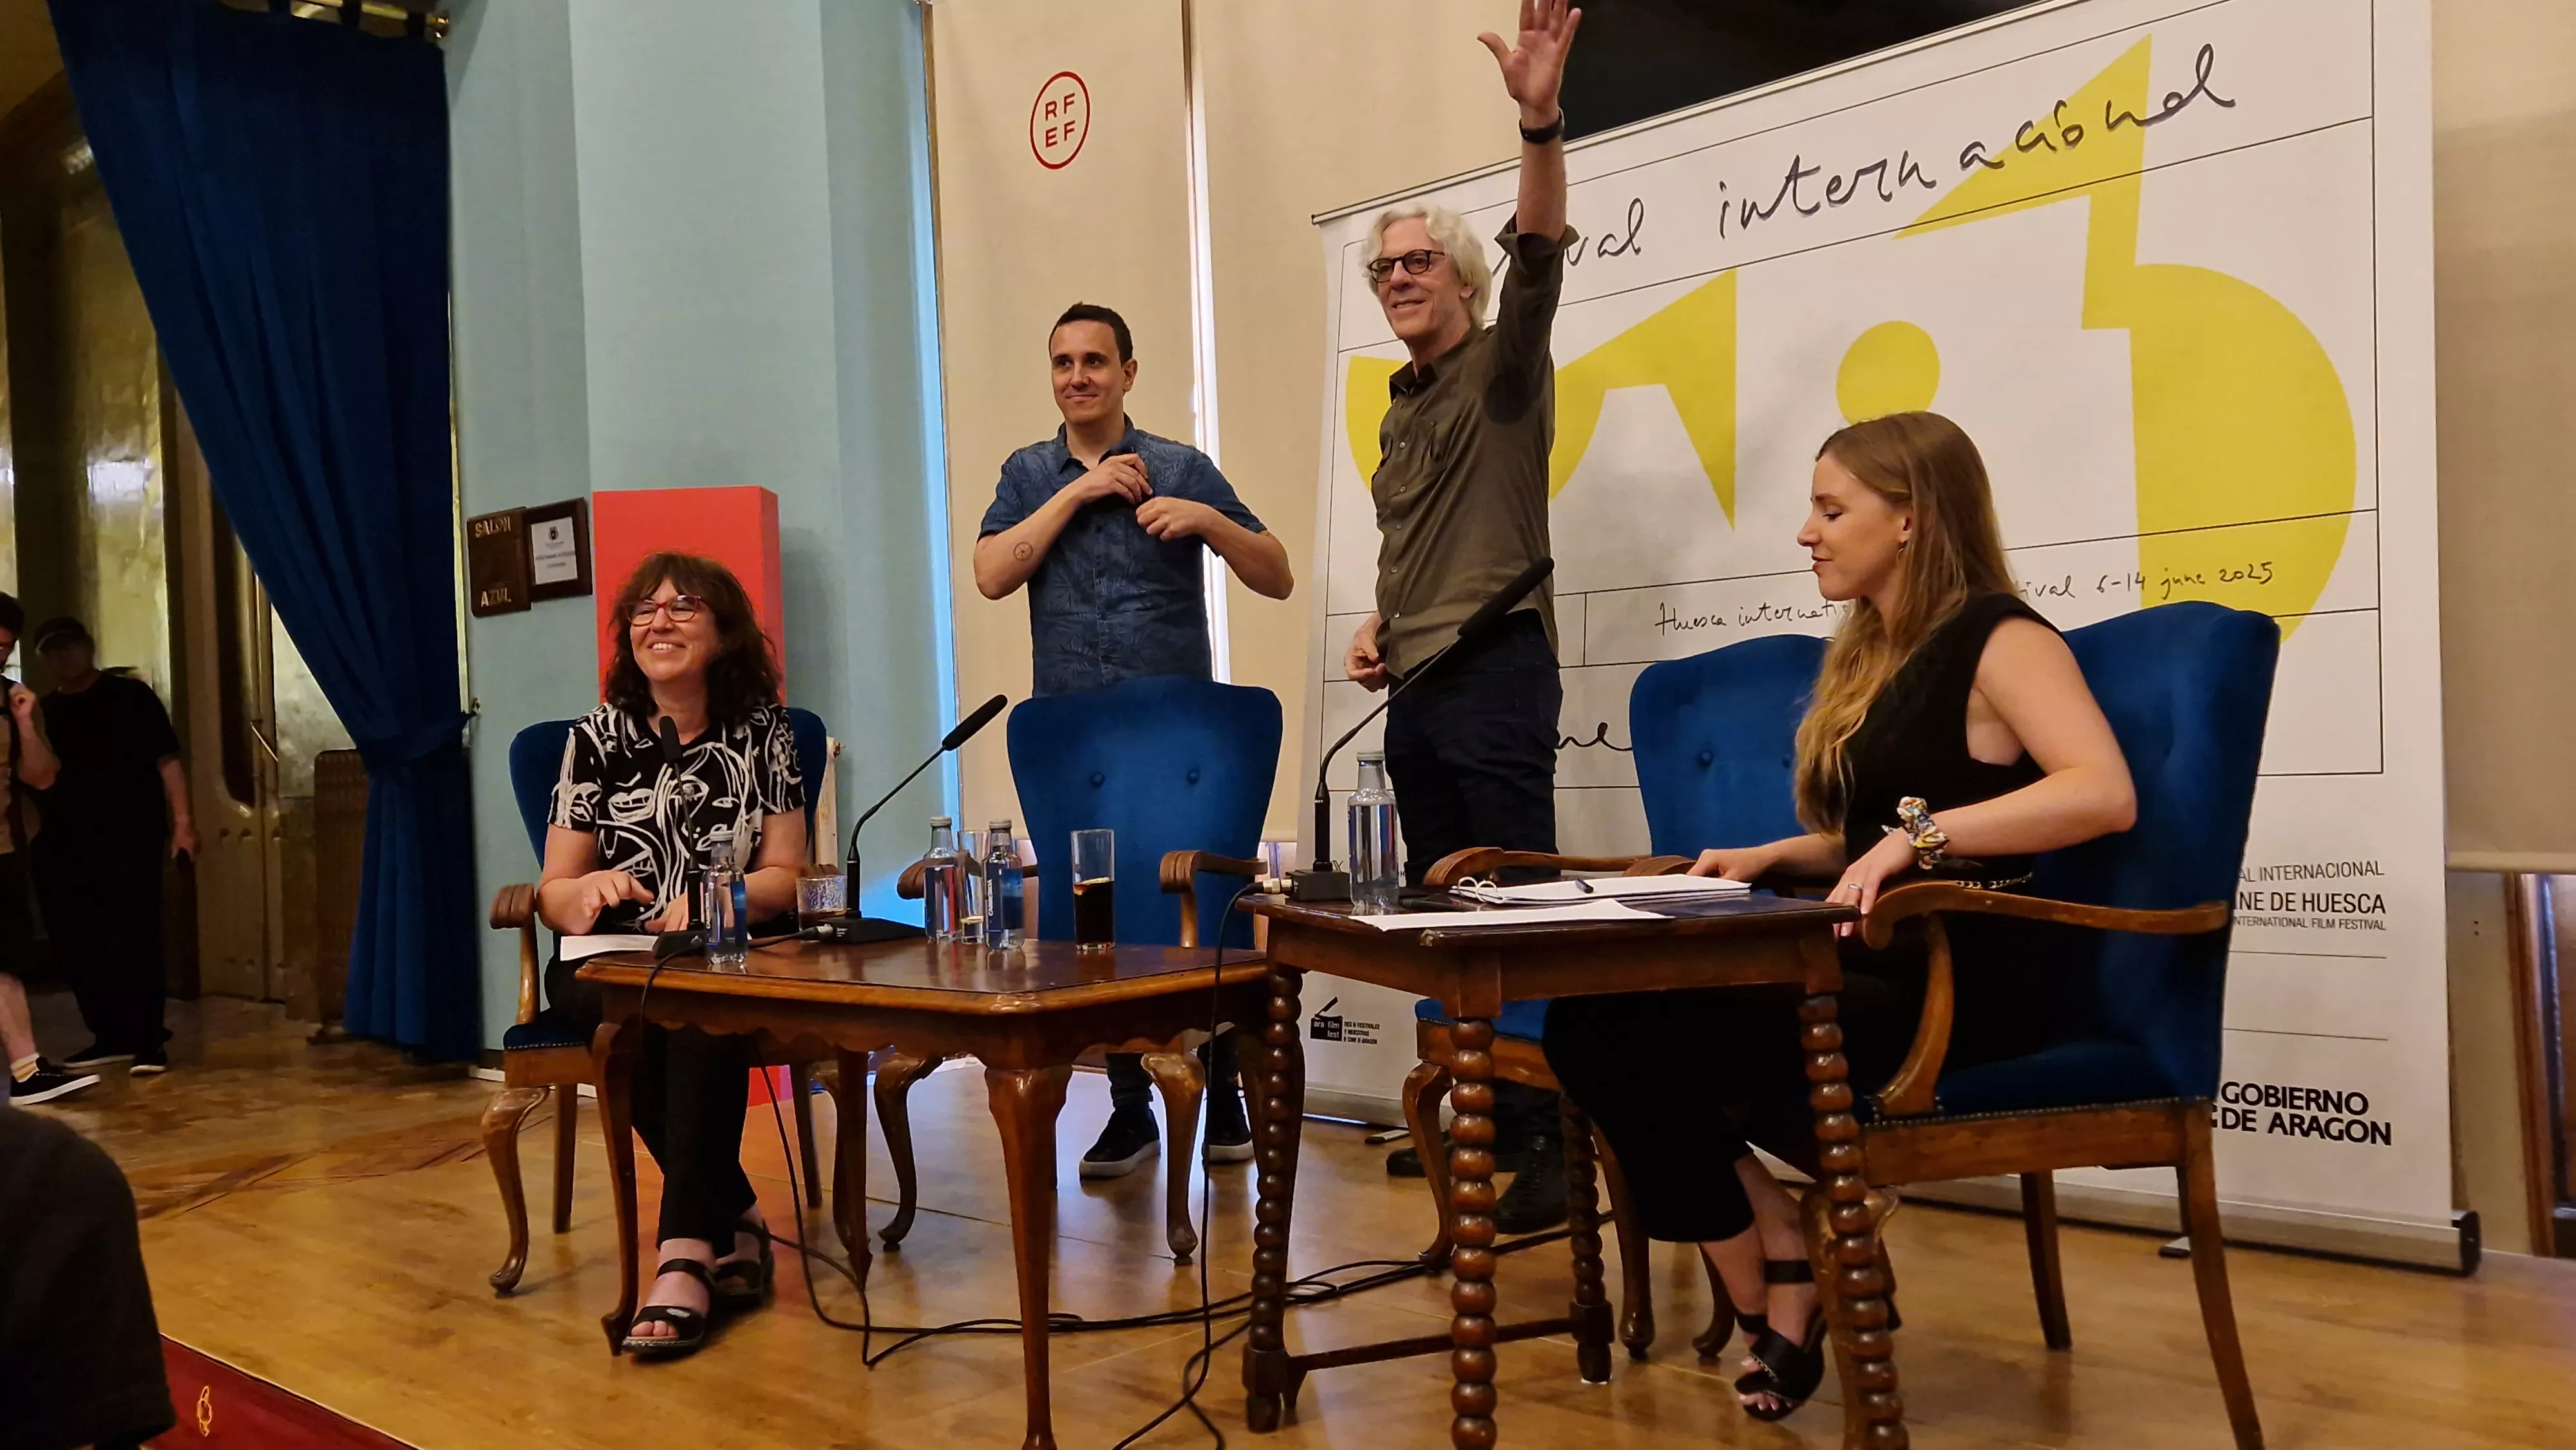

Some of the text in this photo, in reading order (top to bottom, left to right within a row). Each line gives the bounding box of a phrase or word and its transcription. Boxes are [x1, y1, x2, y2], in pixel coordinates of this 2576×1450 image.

[1654, 601, 1727, 636] Huesca
[2018, 574, 2076, 600] ival
[2096, 571, 2146, 593] 6-14
[2160, 567, 2206, 599] june
[2219, 561, 2274, 585] 2025
[2259, 860, 2385, 881] INTERNACIONAL
[2234, 890, 2387, 914] INE DE HUESCA
[2235, 915, 2387, 930] NTERNATIONAL FILM FESTIVAL
[1328, 1021, 1340, 1029] film
[2221, 1081, 2369, 1116] GOBIERNO
[2221, 1107, 2392, 1147] DE ARAGON
